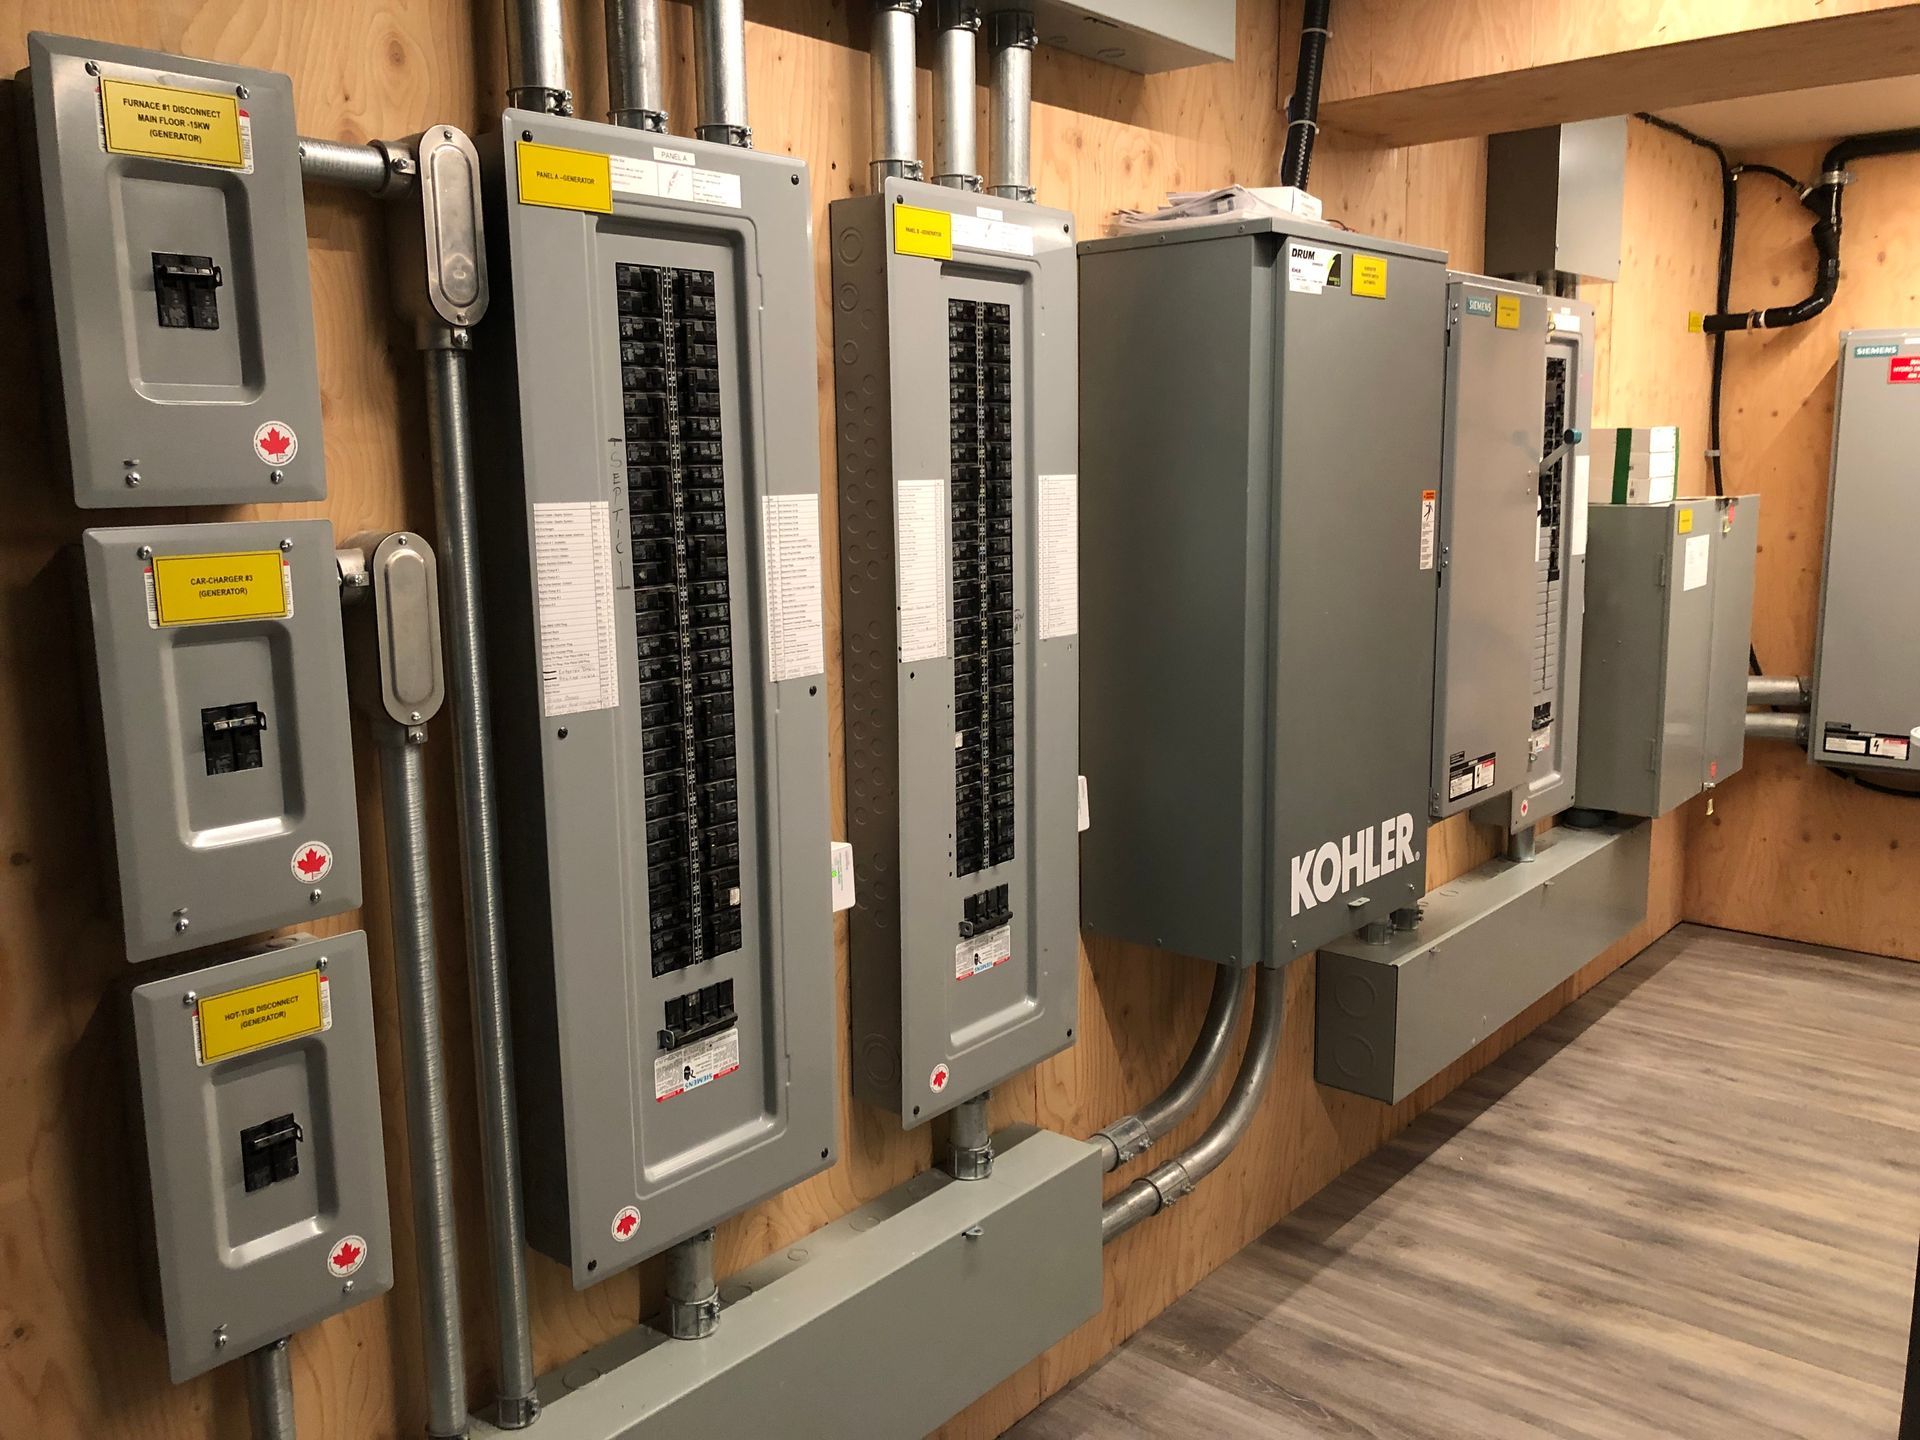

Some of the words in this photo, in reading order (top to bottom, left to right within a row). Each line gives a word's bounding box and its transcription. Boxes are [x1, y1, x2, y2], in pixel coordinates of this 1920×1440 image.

[123, 98, 161, 111] FURNACE
[172, 104, 221, 118] DISCONNECT
[137, 113, 158, 124] MAIN
[159, 116, 186, 127] FLOOR
[149, 129, 202, 144] (GENERATOR)
[661, 151, 681, 161] PANEL
[1291, 248, 1316, 260] DRUM
[1468, 300, 1492, 312] SIEMENS
[1856, 346, 1897, 355] SIEMENS
[191, 575, 243, 586] CAR-CHARGER
[199, 587, 248, 599] (GENERATOR)
[1290, 812, 1415, 918] KOHLER
[224, 1008, 255, 1021] HOT-TUB
[256, 995, 299, 1012] DISCONNECT
[240, 1010, 287, 1030] (GENERATOR)
[684, 1072, 713, 1090] SIEMENS
